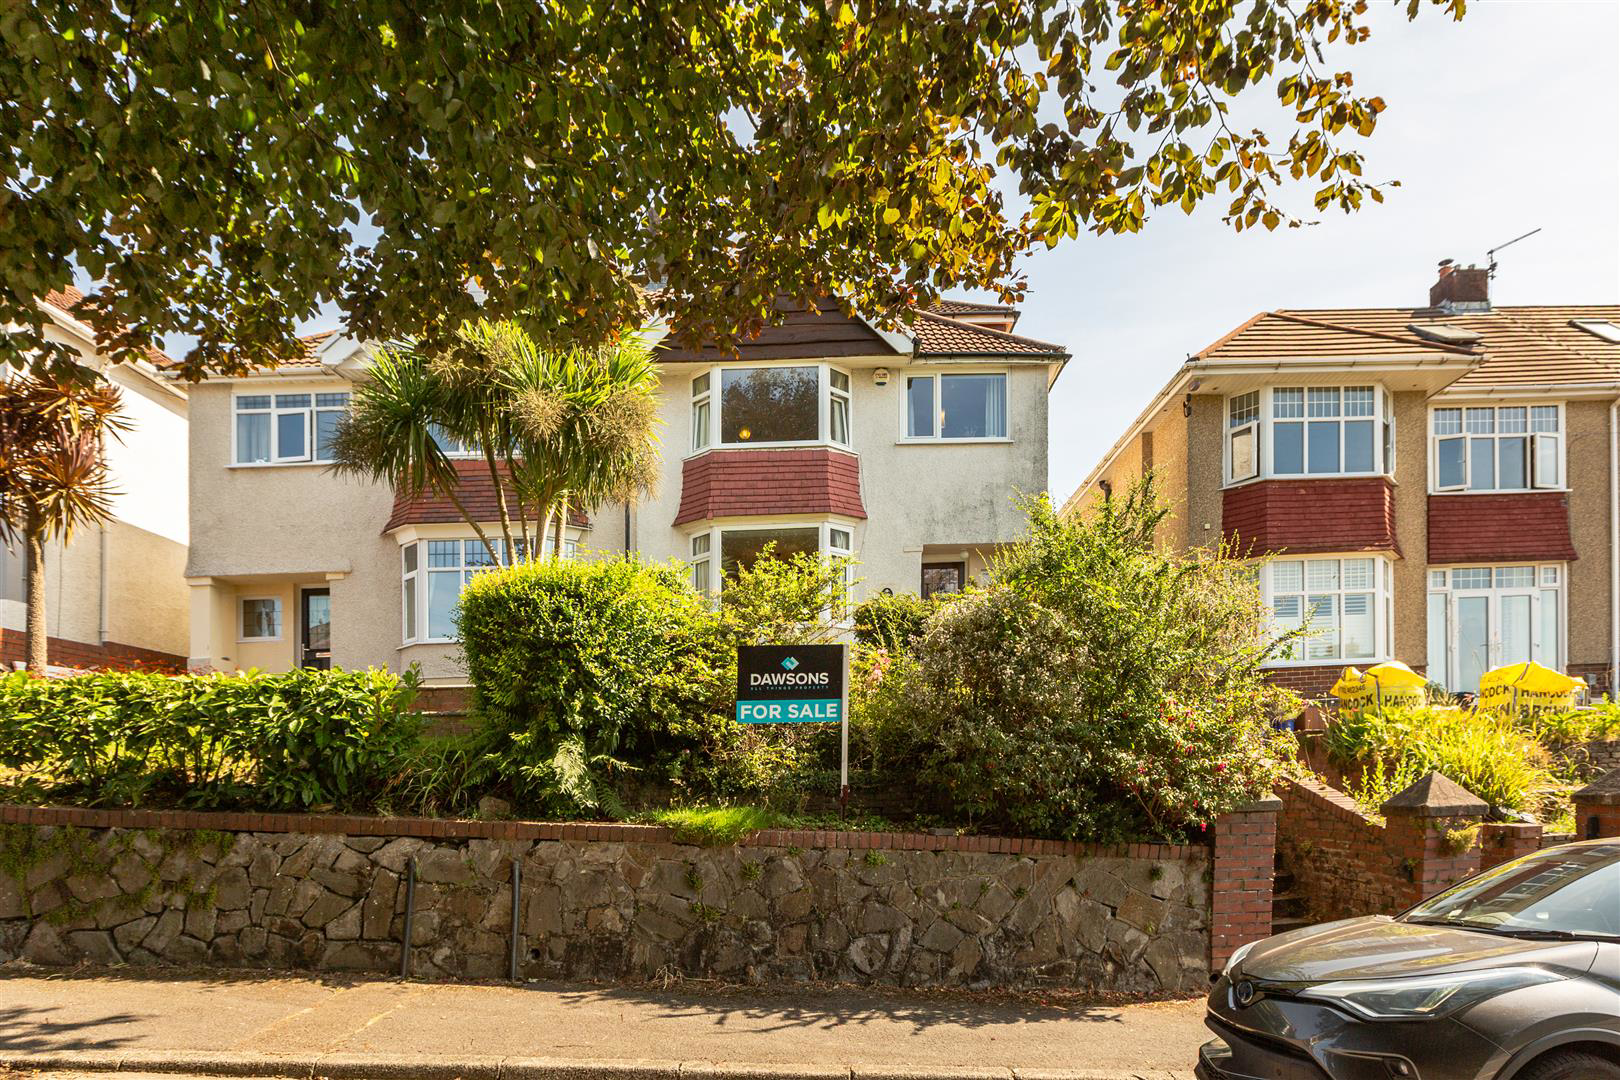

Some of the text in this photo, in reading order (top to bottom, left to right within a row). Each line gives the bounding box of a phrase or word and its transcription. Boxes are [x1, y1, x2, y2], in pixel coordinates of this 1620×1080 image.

[750, 673, 829, 685] DAWSONS
[740, 703, 838, 720] FOR SALE
